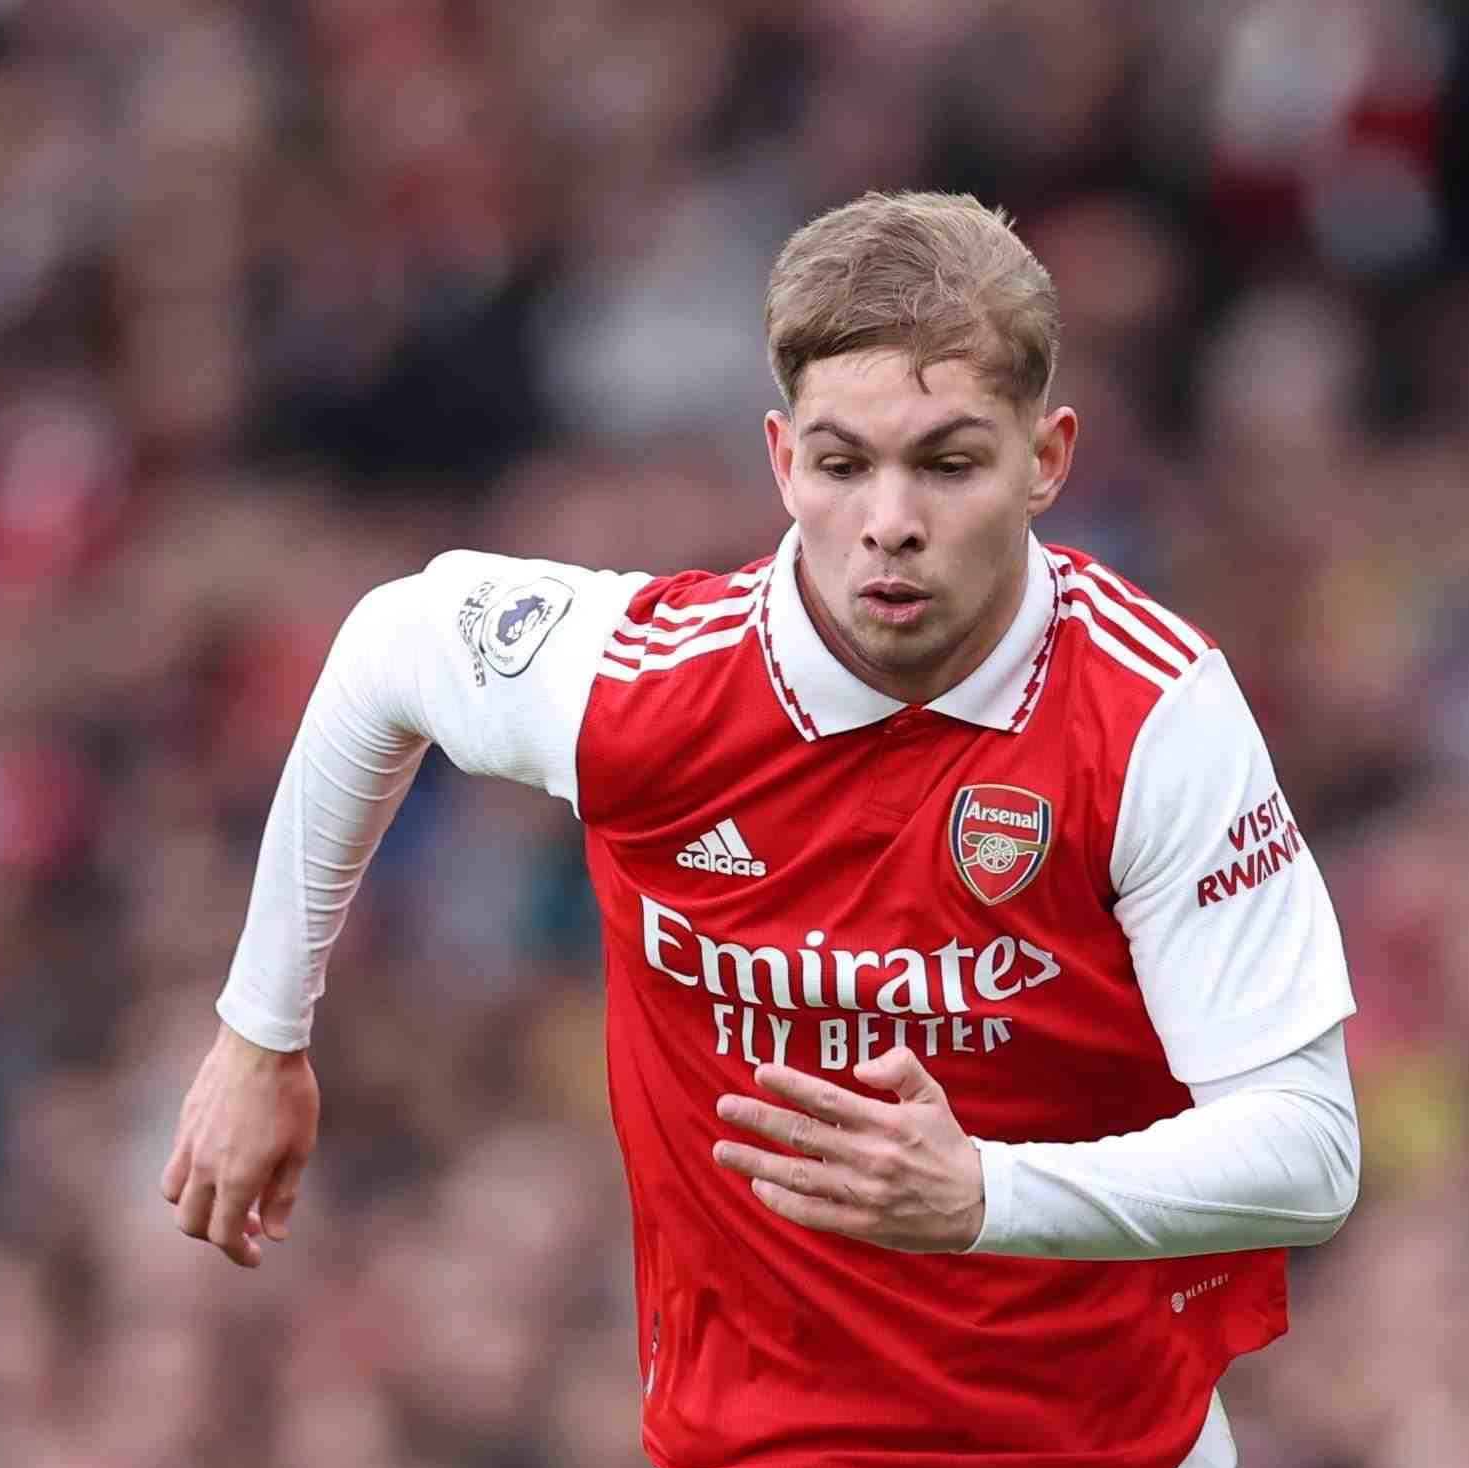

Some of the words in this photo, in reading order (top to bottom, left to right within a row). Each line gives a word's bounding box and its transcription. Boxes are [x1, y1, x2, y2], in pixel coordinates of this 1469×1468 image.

[965, 800, 1039, 831] Arsenal
[1227, 791, 1285, 851] VISIT
[675, 850, 767, 877] adidas
[639, 893, 1062, 1015] Emirates
[713, 1002, 794, 1067] FLY
